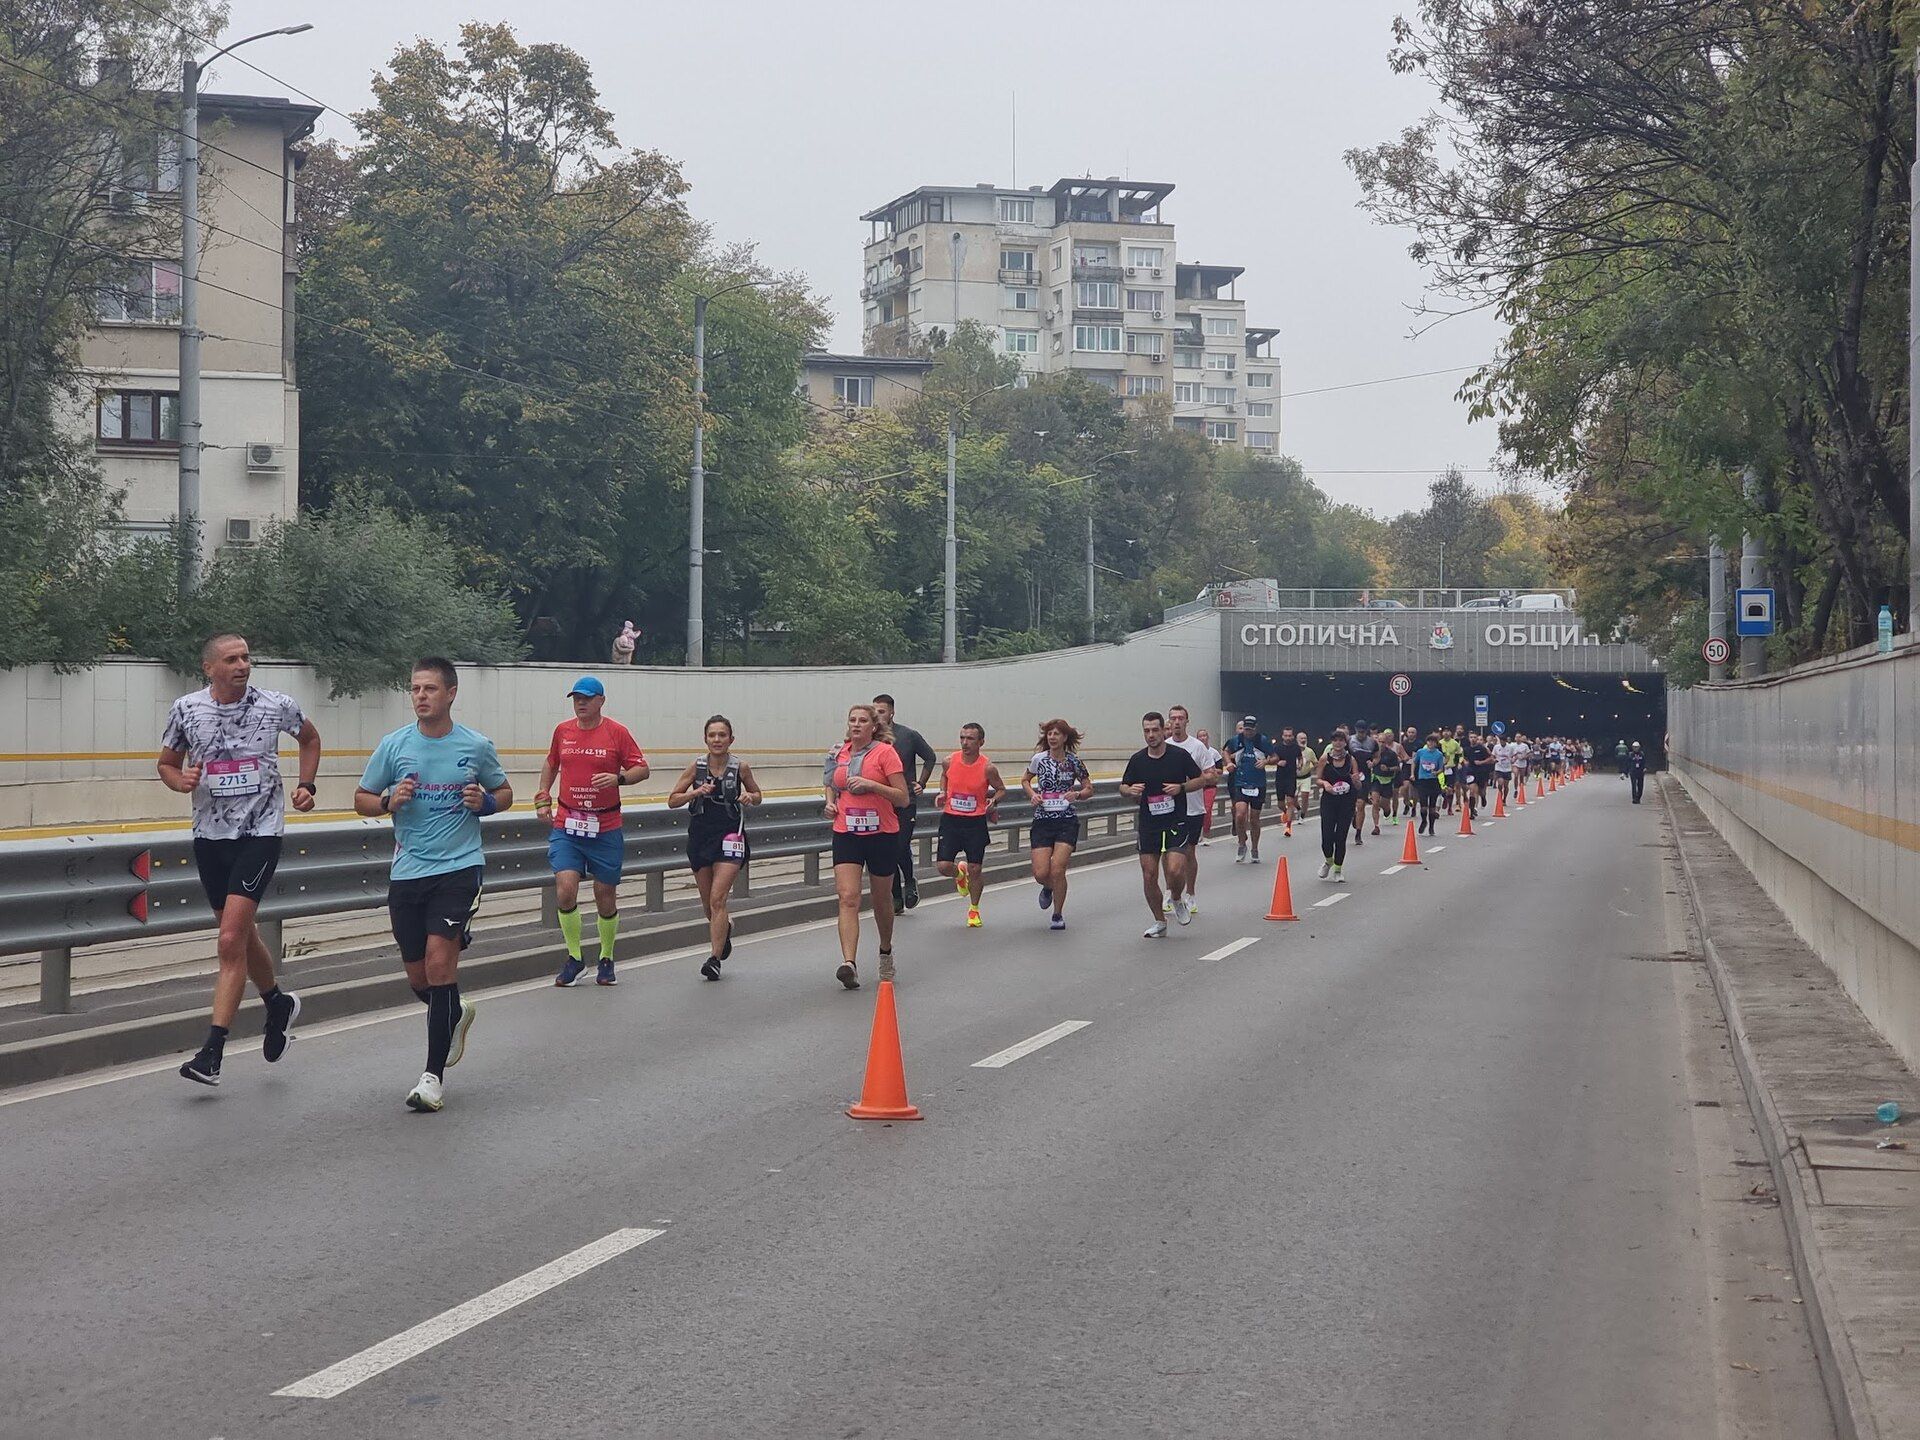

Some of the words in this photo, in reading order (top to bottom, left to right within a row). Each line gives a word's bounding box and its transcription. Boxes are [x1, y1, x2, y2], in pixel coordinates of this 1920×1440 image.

[1240, 624, 1400, 646] СТОЛИЧНА
[1708, 644, 1724, 658] 50
[1394, 681, 1408, 690] 50
[219, 774, 248, 786] 2713
[424, 783, 441, 791] AIR
[575, 821, 589, 830] 182
[855, 817, 868, 825] 811
